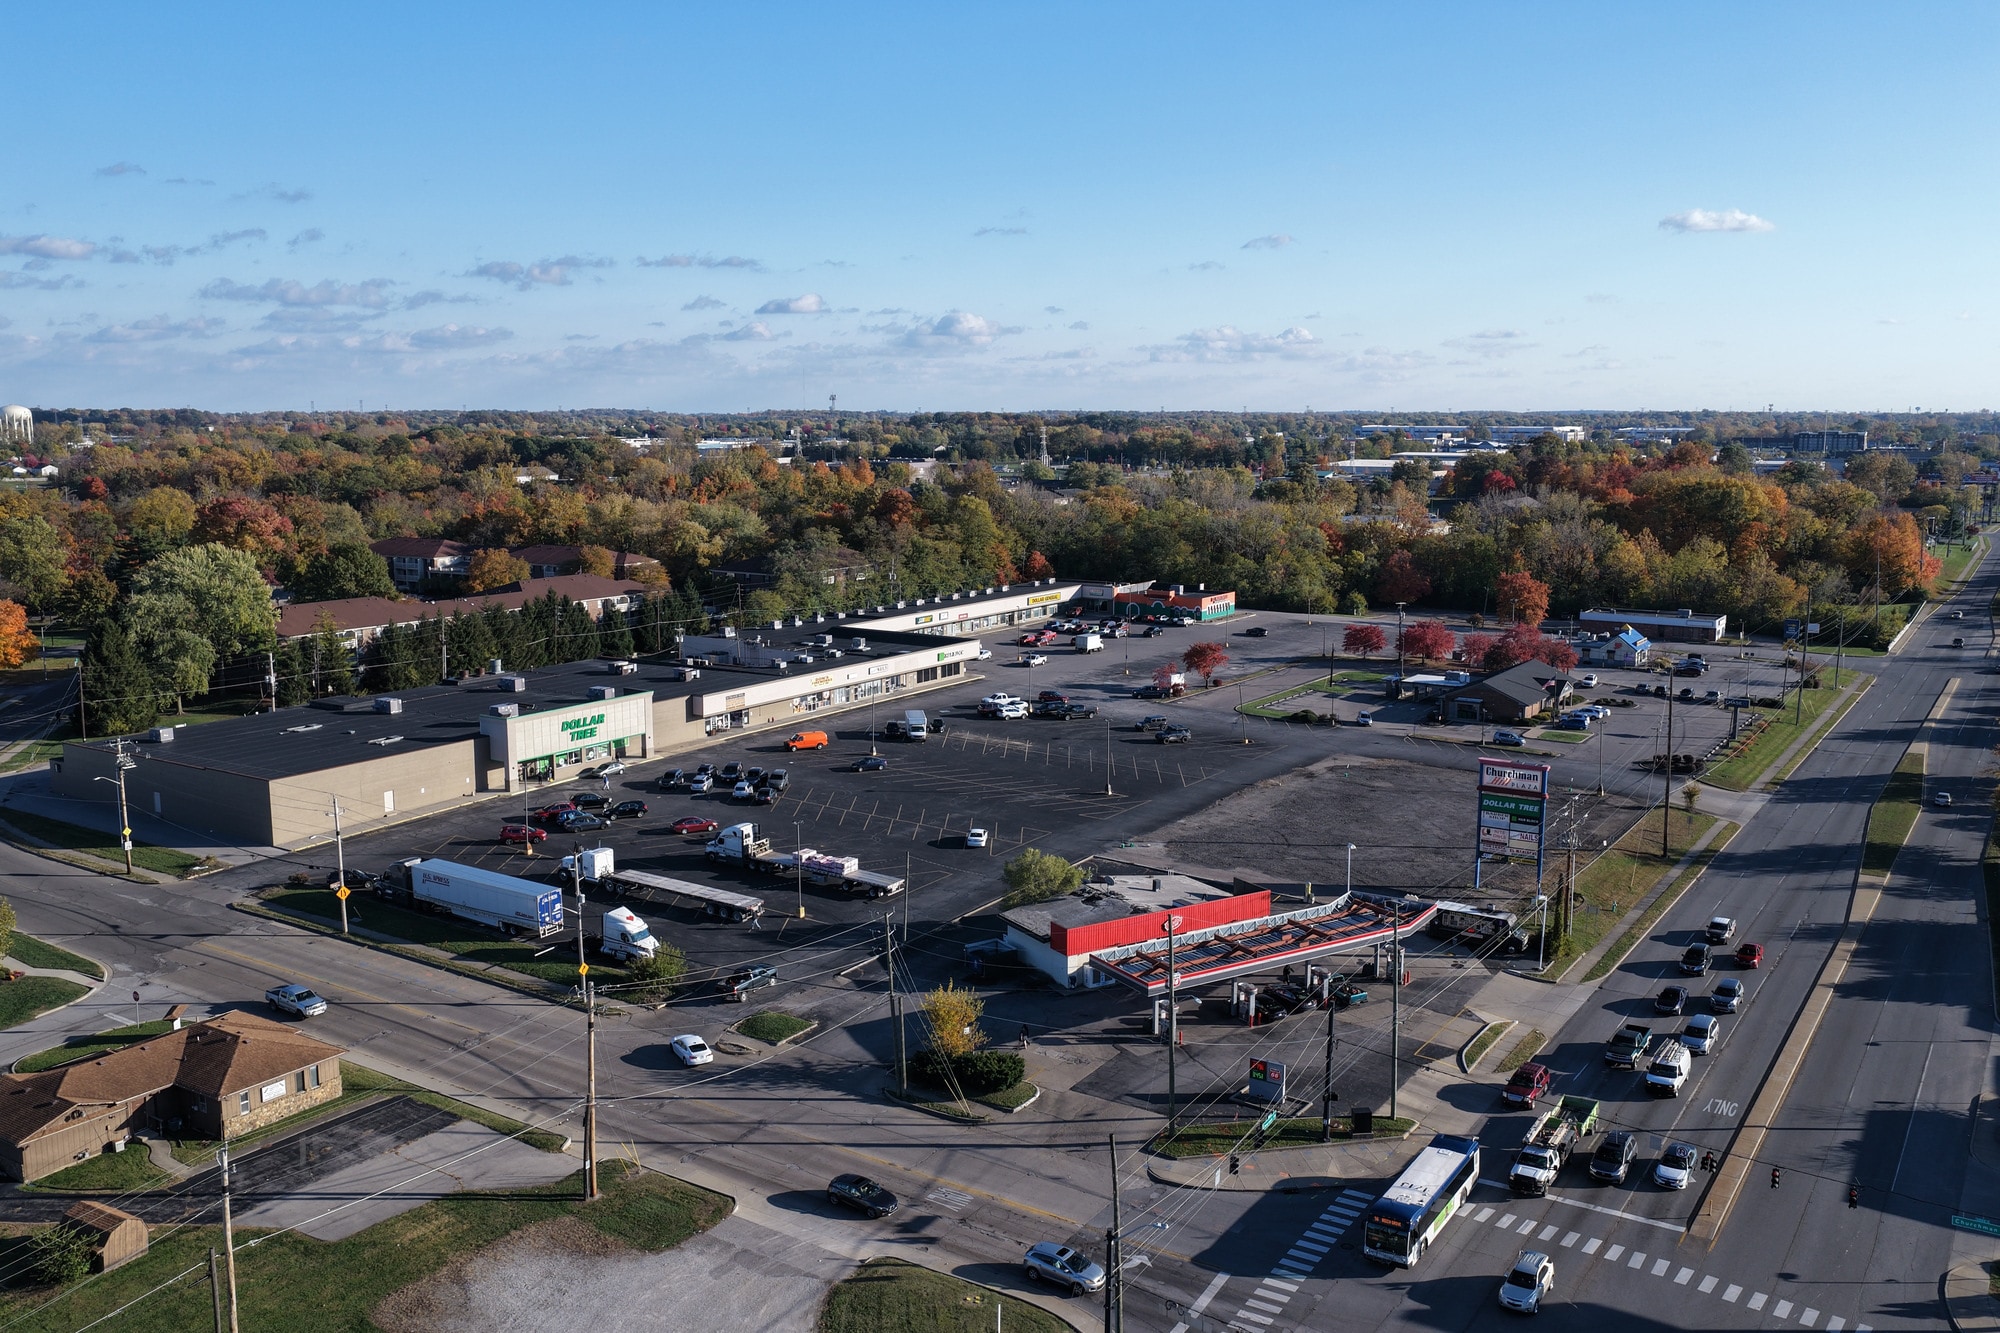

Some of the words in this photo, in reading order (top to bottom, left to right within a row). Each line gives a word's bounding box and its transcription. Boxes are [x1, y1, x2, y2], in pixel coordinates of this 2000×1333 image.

[561, 713, 605, 732] DOLLAR
[569, 726, 598, 742] TREE
[1486, 766, 1538, 781] Churchman
[1511, 782, 1538, 790] PLAZA
[1483, 799, 1516, 809] DOLLAR
[1519, 803, 1540, 812] TREE
[1520, 833, 1539, 841] NAILS
[1702, 1098, 1739, 1117] ONLY
[1955, 1218, 1998, 1232] Churchman
